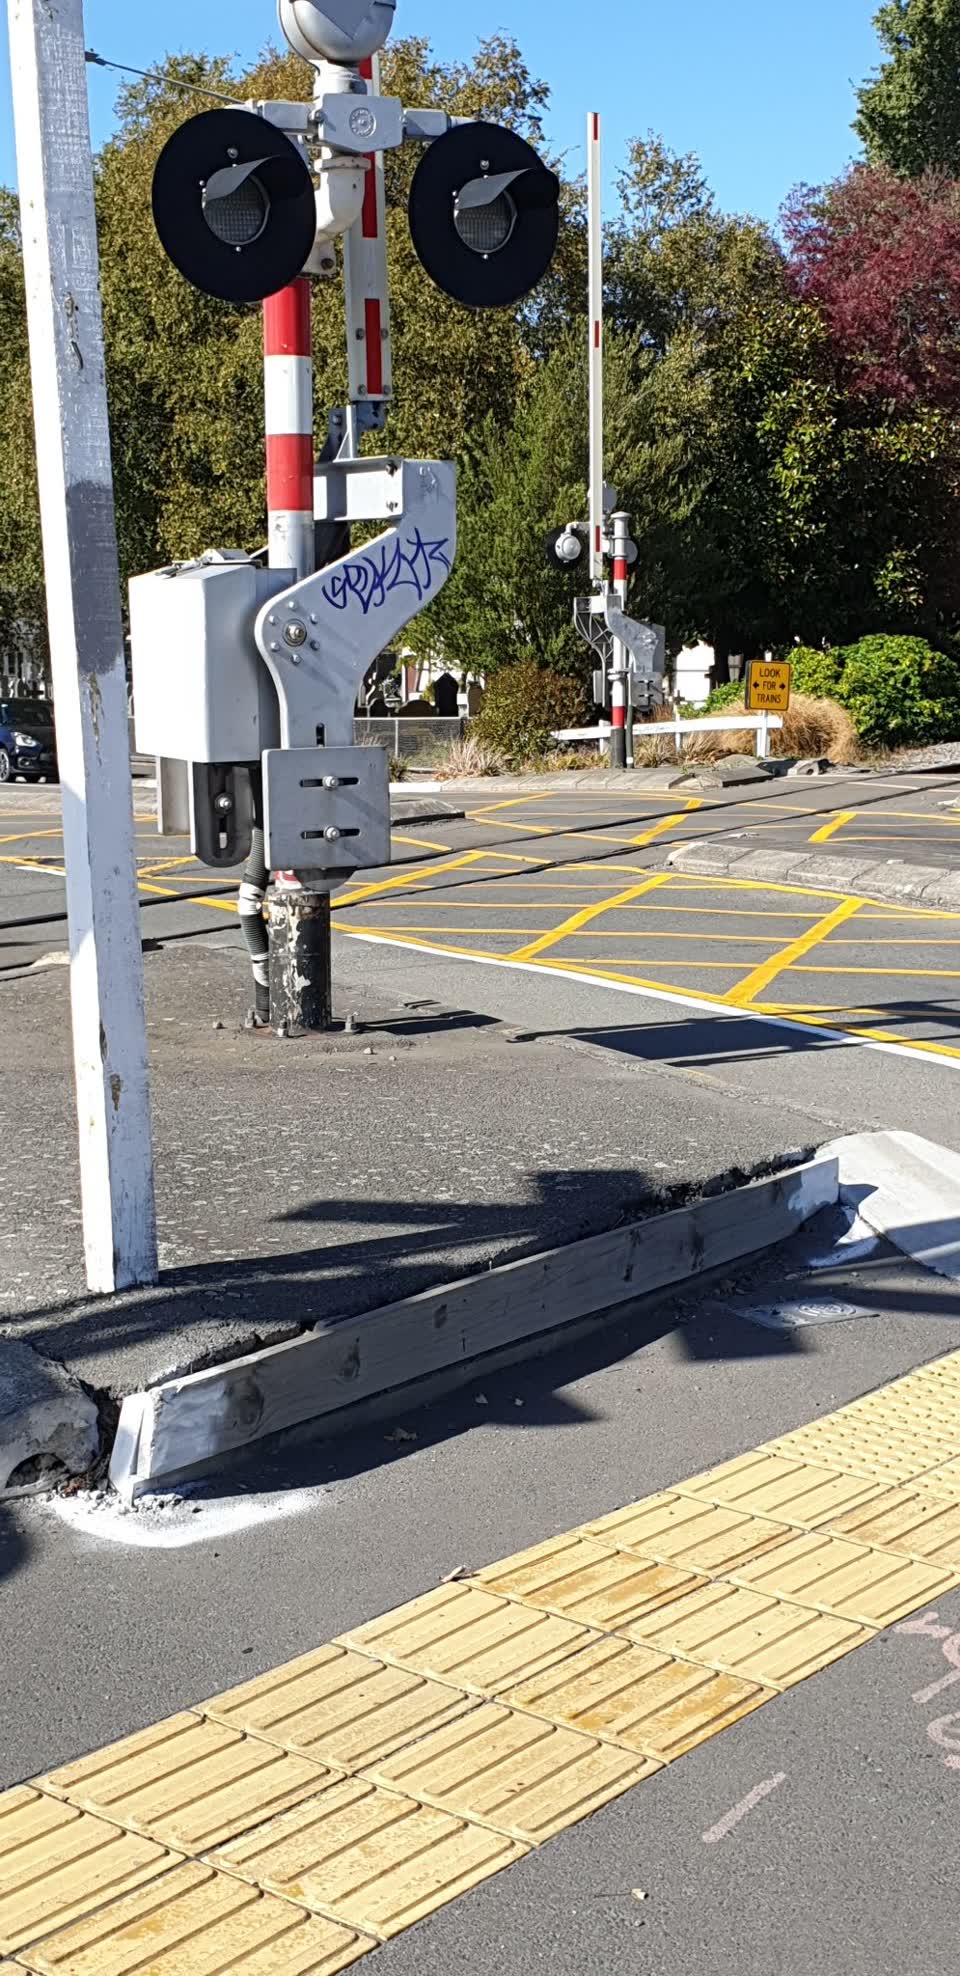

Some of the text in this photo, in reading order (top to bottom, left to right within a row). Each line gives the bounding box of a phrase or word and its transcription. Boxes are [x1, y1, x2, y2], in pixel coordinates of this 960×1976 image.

[759, 668, 781, 678] LOOK
[762, 681, 777, 690] FOR
[757, 693, 781, 704] TRAINS
